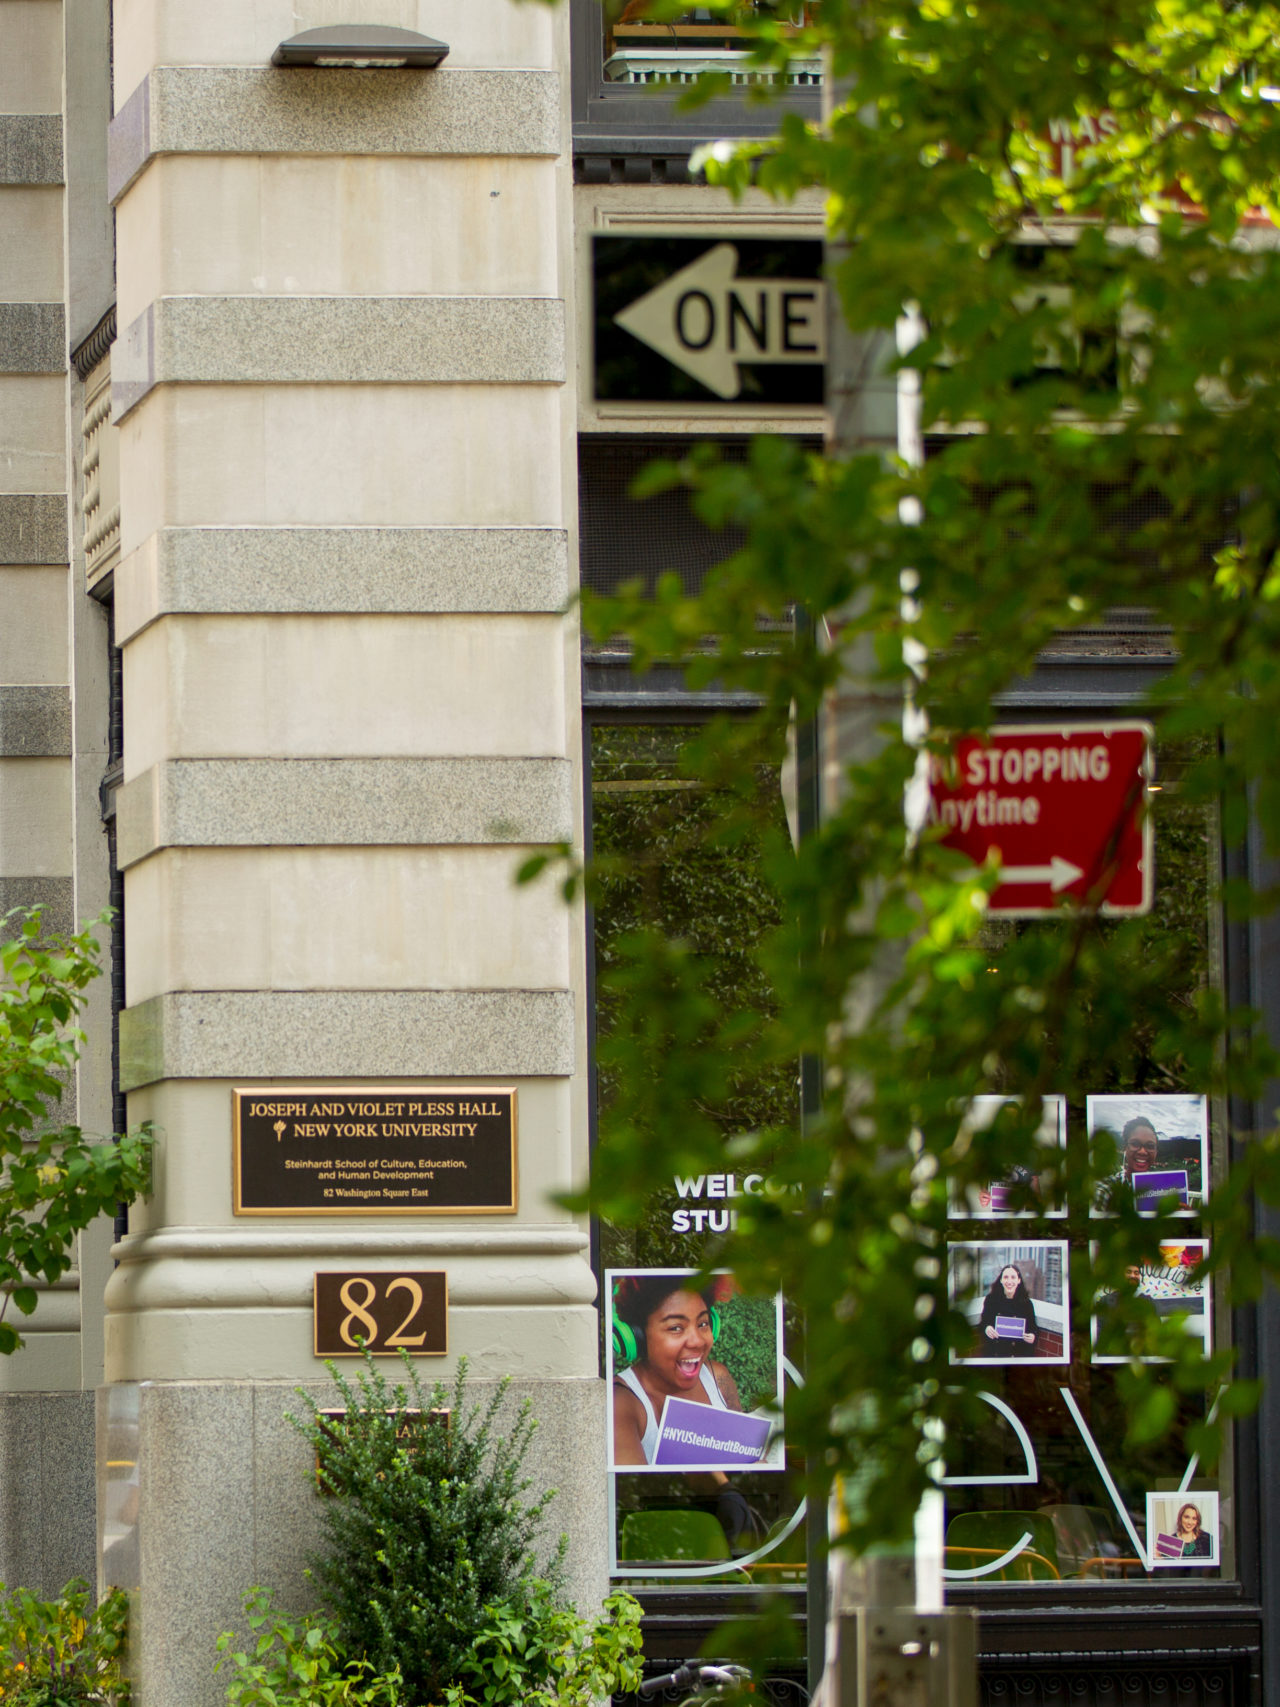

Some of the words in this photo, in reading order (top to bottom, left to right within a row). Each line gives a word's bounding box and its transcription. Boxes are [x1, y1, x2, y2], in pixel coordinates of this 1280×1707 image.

[675, 290, 818, 352] ONE
[967, 745, 1110, 786] STOPPING
[249, 1103, 307, 1117] JOSEPH
[310, 1103, 345, 1116] AND
[347, 1103, 405, 1116] VIOLET
[408, 1103, 455, 1116] PLESS
[458, 1103, 502, 1116] HALL
[294, 1123, 331, 1137] NEW
[334, 1123, 378, 1137] YORK
[381, 1123, 478, 1137] UNIVERSITY
[285, 1159, 332, 1169] Steinhardt
[335, 1159, 366, 1169] School
[368, 1159, 379, 1169] of
[380, 1159, 416, 1170] Culture,
[419, 1159, 467, 1170] Education,
[318, 1170, 336, 1180] and
[338, 1170, 370, 1180] Human
[373, 1170, 434, 1181] Development
[323, 1188, 334, 1198] 82
[335, 1188, 381, 1199] Washington
[383, 1188, 409, 1199] Square
[411, 1188, 428, 1198] East
[339, 1277, 427, 1348] 82
[663, 1426, 763, 1457] #NYUSteinhardtBound
